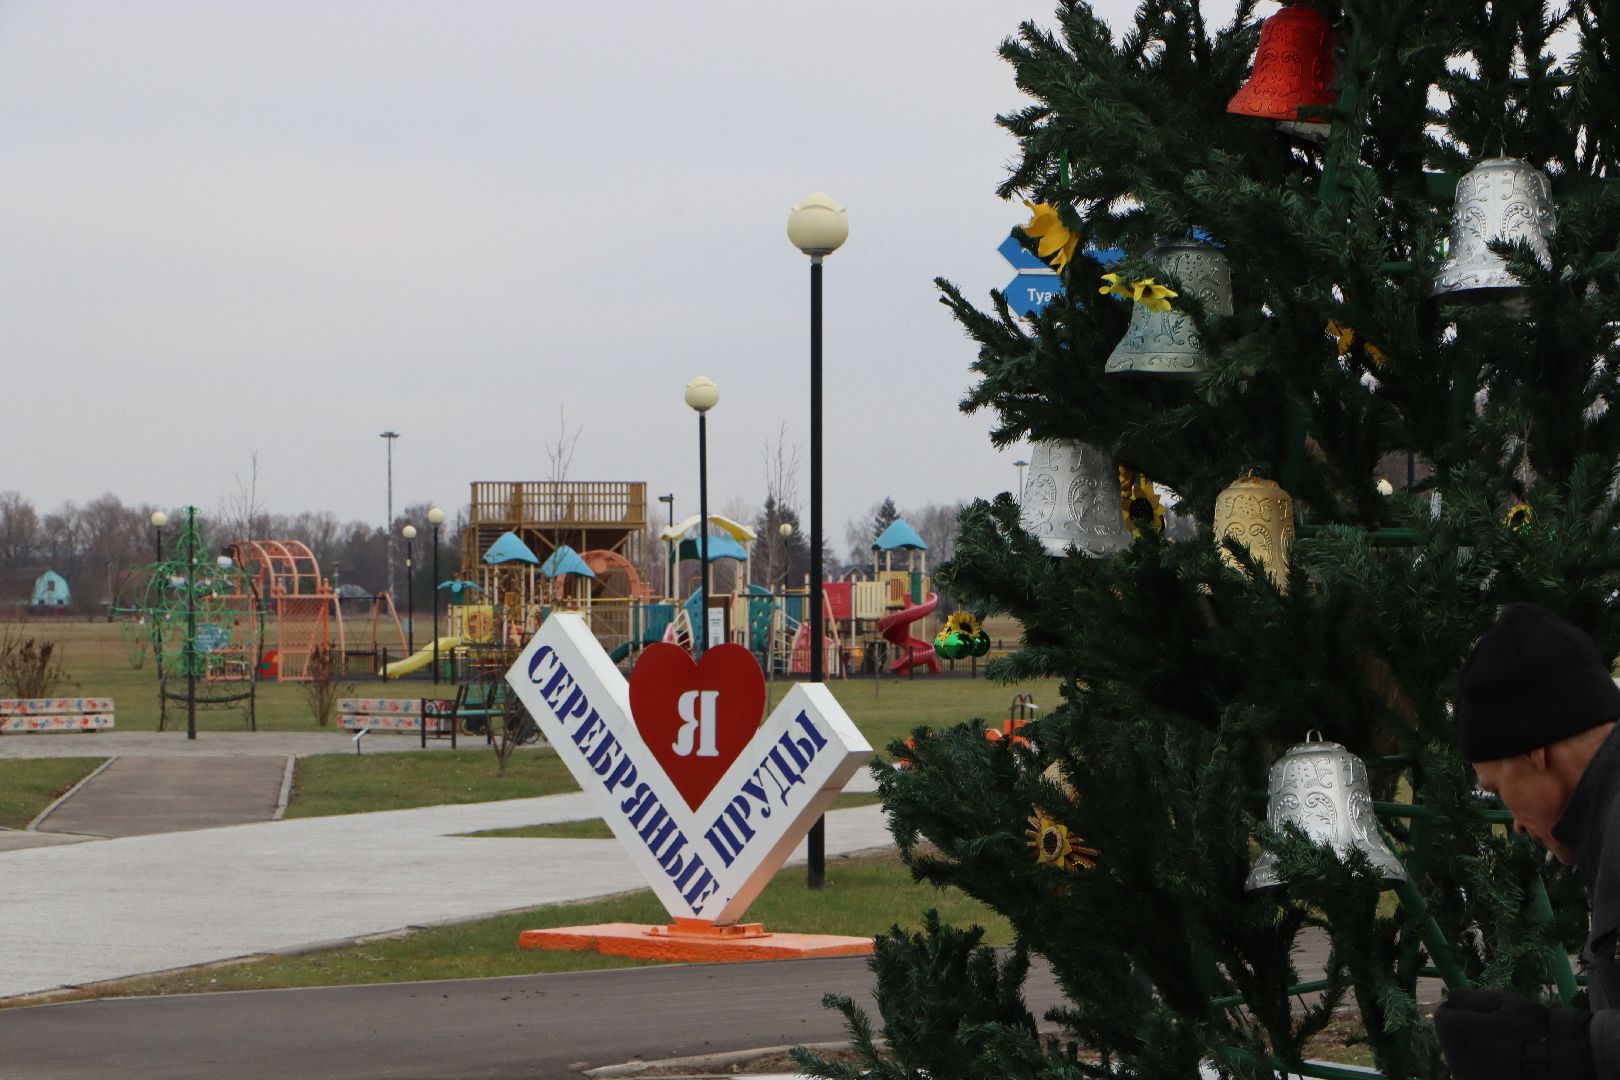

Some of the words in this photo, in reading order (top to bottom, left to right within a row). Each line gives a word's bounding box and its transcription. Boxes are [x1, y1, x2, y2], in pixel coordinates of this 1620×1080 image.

[1027, 287, 1065, 305] Туа
[672, 690, 720, 757] Я
[528, 645, 721, 916] СЕРЕБРЯНЫЕ
[703, 709, 828, 869] ПРУДЫ
